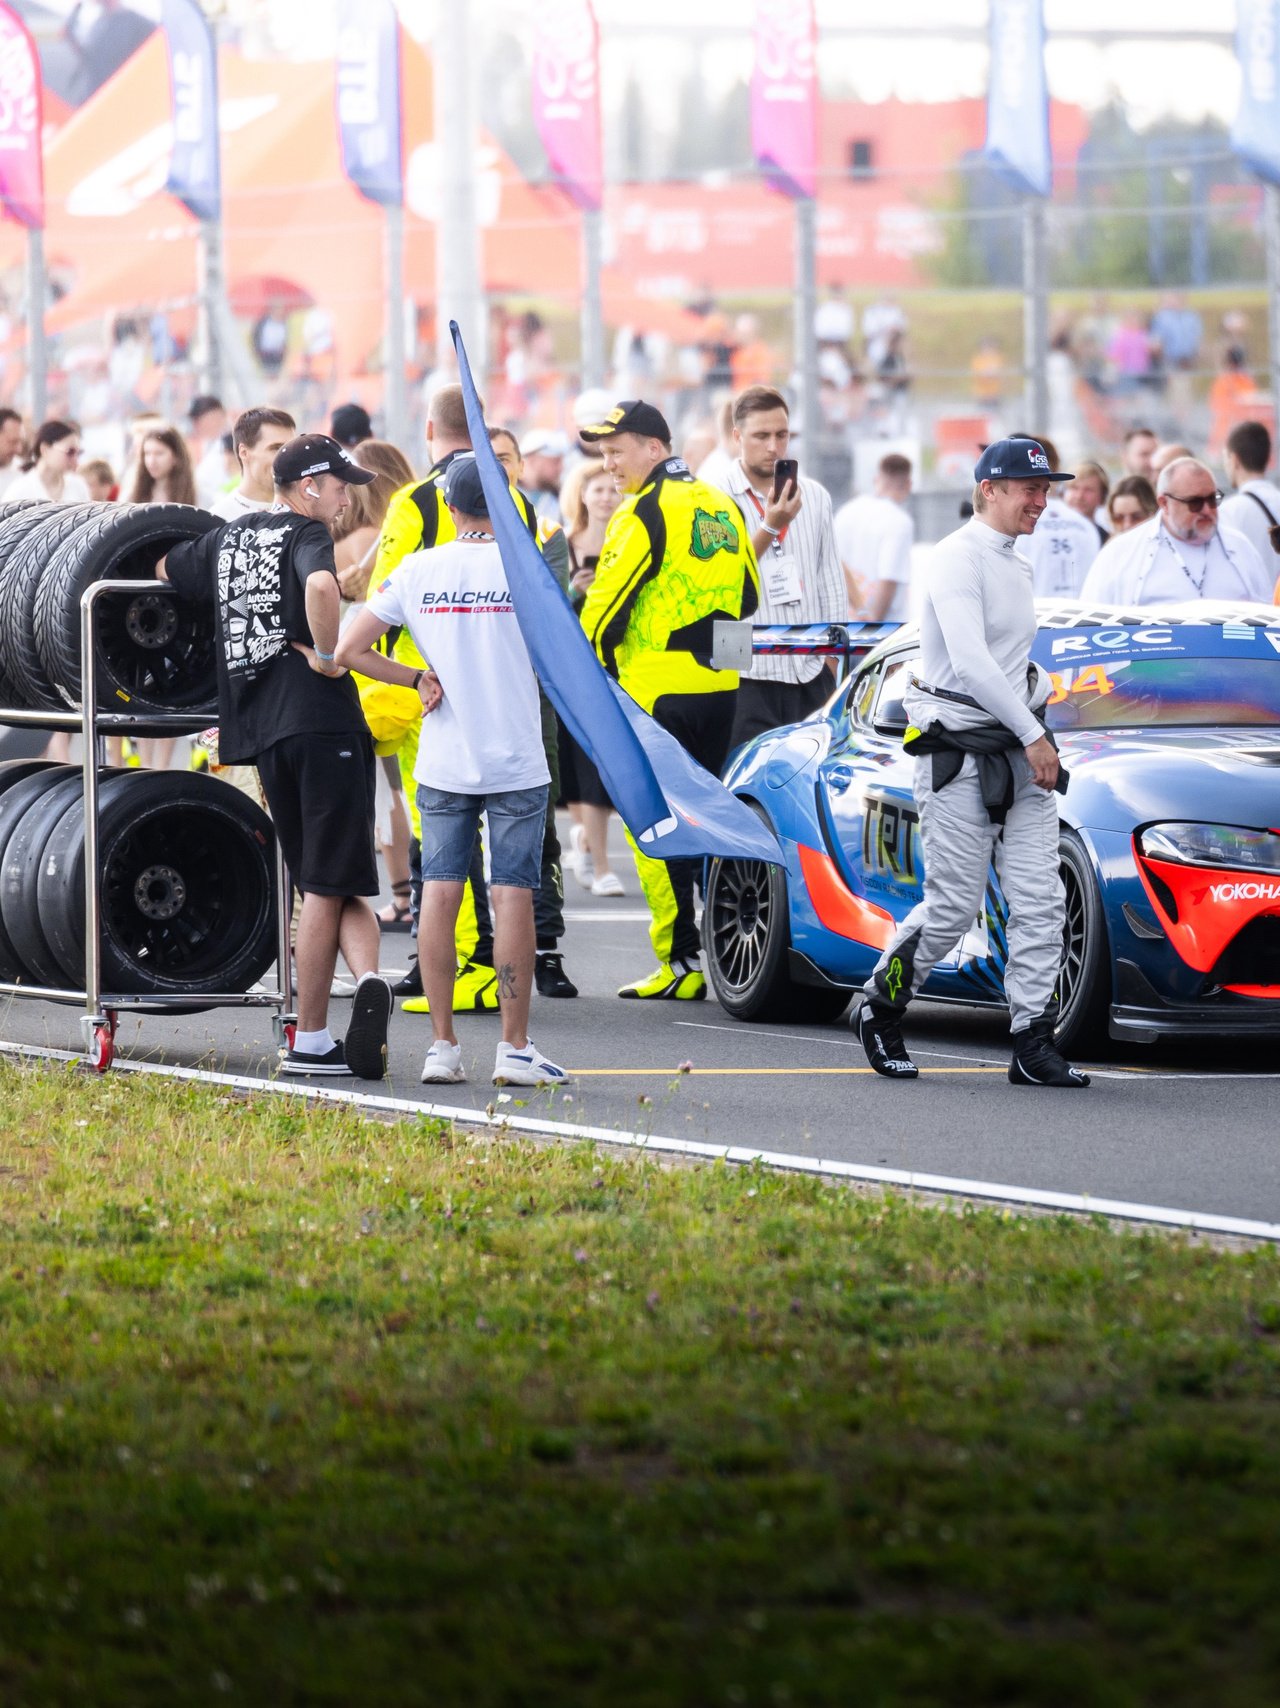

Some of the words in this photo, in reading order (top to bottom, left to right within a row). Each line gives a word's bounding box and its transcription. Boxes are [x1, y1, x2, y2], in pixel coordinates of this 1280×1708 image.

[248, 590, 281, 602] Autolab
[252, 602, 274, 613] RCC
[862, 795, 920, 882] TRT
